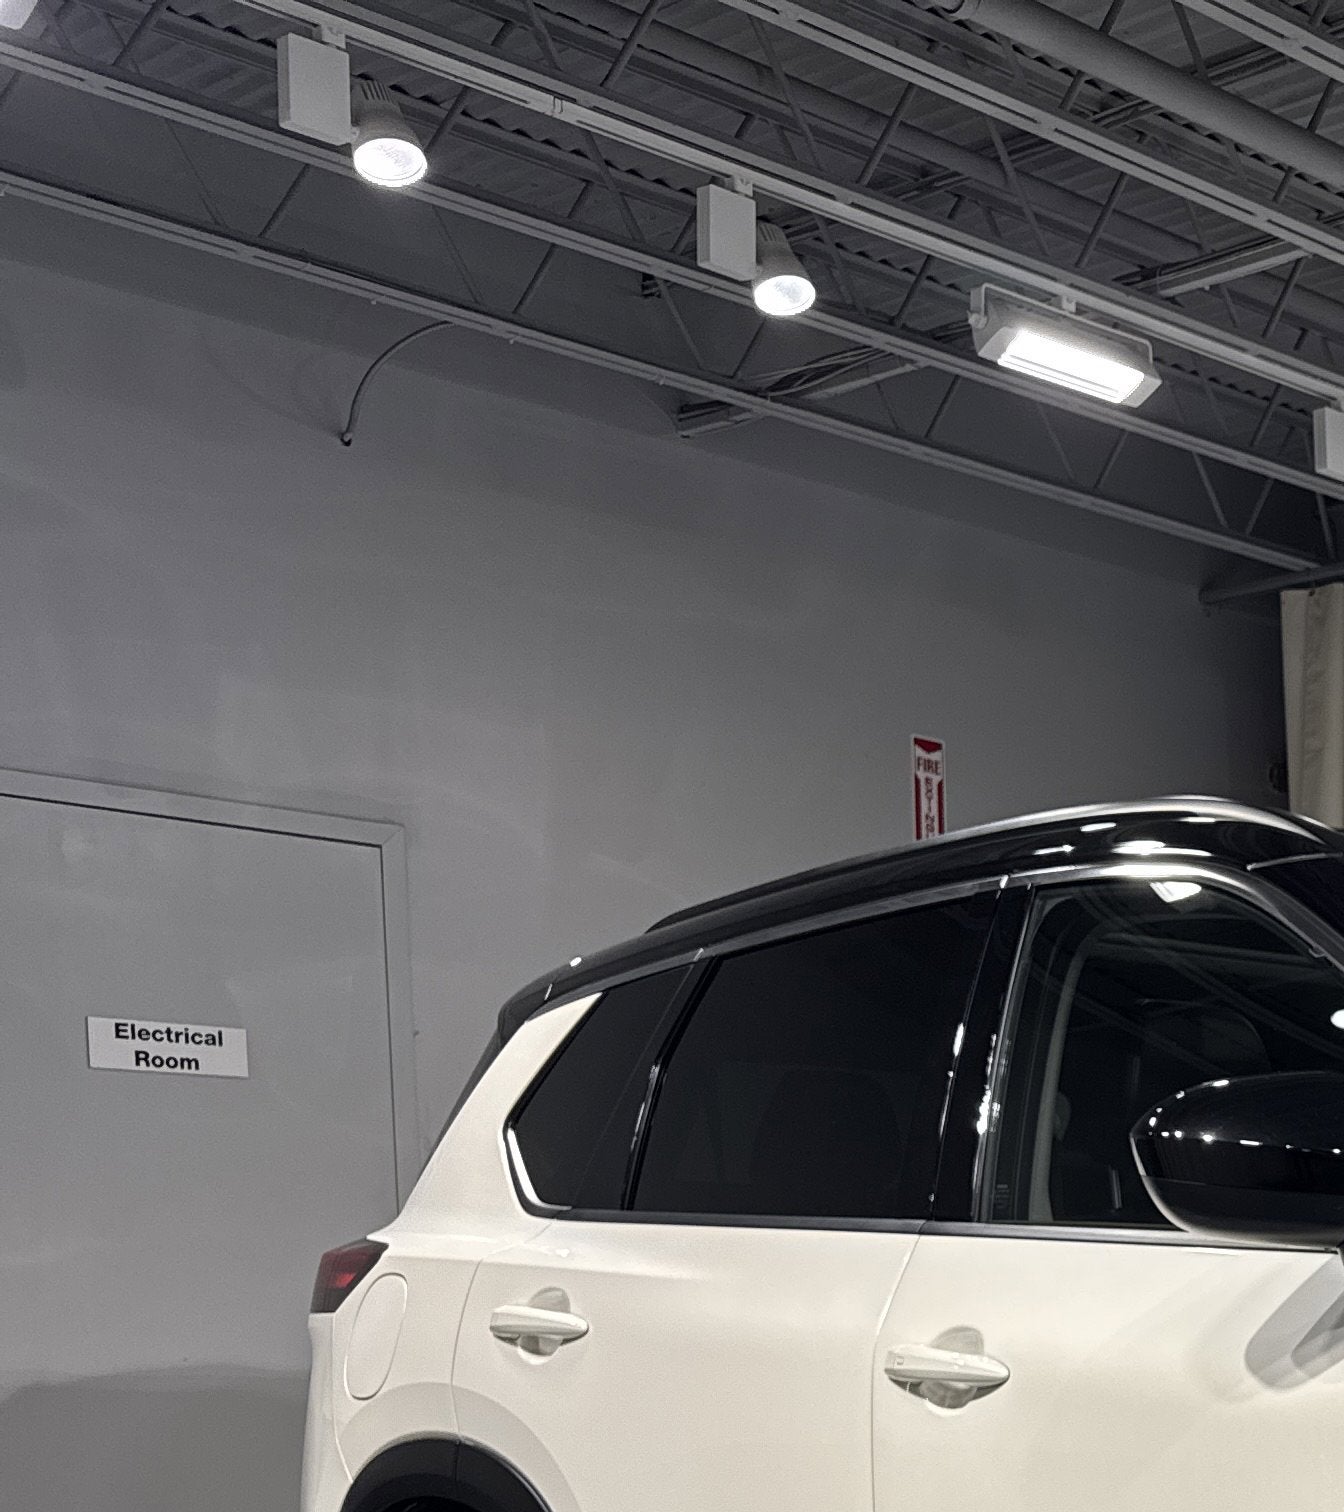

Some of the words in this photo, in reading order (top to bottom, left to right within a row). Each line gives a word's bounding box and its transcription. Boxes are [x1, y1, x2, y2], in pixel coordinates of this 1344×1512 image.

[917, 756, 941, 776] FIRE
[114, 1022, 223, 1047] Electrical
[134, 1050, 200, 1070] Room
